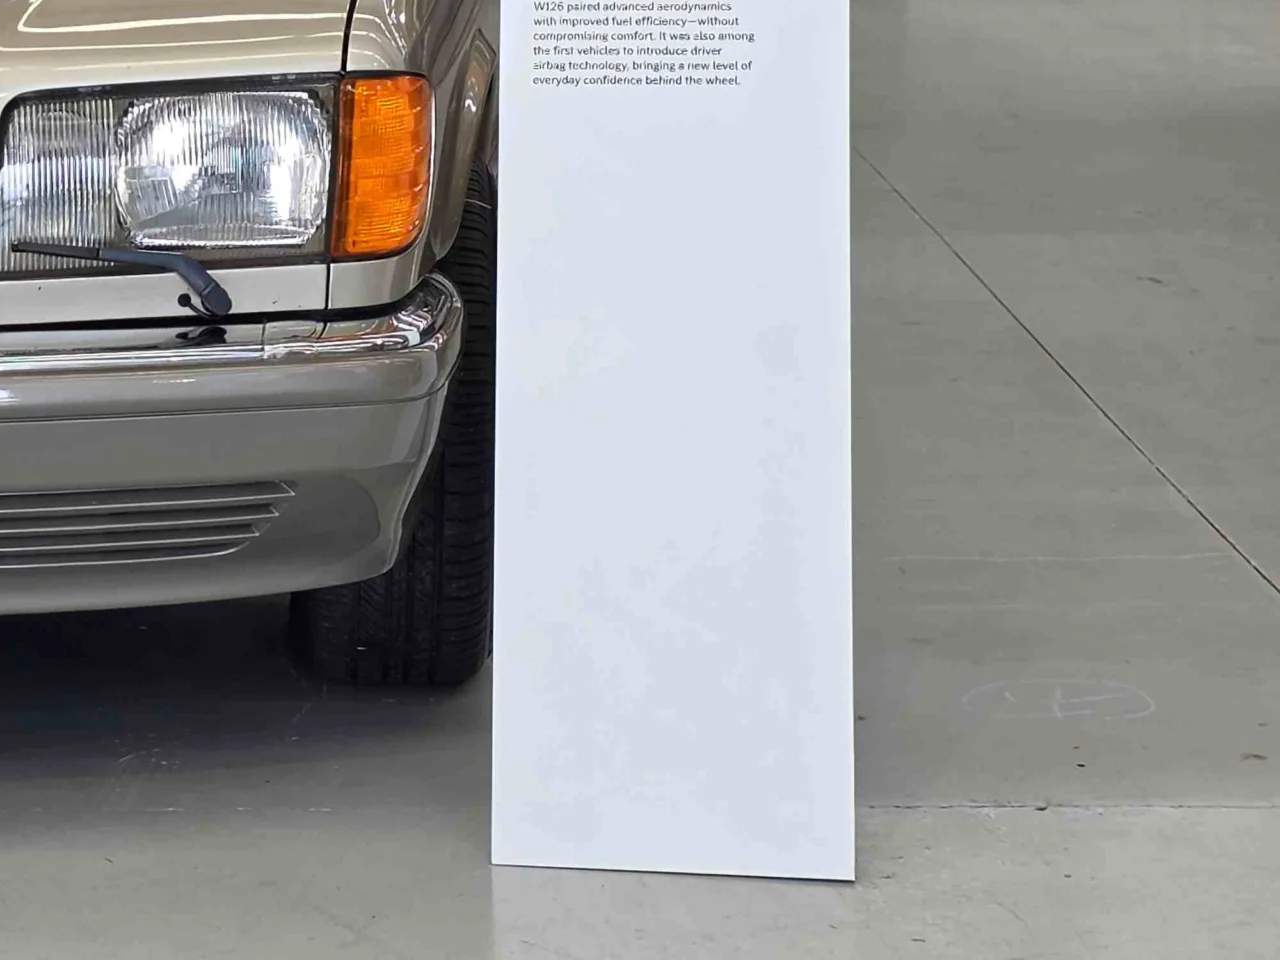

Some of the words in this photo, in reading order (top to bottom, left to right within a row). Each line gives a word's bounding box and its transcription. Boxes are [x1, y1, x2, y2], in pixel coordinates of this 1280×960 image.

[533, 1, 565, 12] W126
[567, 1, 601, 14] paired
[602, 1, 655, 12] advanced
[657, 1, 733, 14] aerodynamics
[533, 16, 557, 27] with
[559, 16, 610, 28] improved
[611, 15, 633, 26] fuel
[532, 31, 609, 43] compromising
[610, 30, 657, 42] comfort.
[659, 31, 667, 41] It
[669, 33, 691, 42] was
[693, 31, 716, 42] also
[718, 33, 756, 44] among
[532, 46, 551, 56] the
[552, 45, 574, 56] first
[577, 45, 621, 56] vehicles
[623, 46, 635, 56] to
[637, 45, 689, 57] introduce
[690, 45, 723, 56] driver
[532, 60, 567, 73] airbag
[568, 60, 630, 73] technology,
[632, 60, 677, 73] bringing
[687, 62, 711, 71] new
[712, 60, 739, 71] level
[740, 60, 753, 71] of
[532, 75, 582, 88] everyday
[583, 75, 643, 86] confidence
[645, 75, 683, 86] behind
[685, 75, 703, 86] the
[705, 75, 742, 86] wheel.
